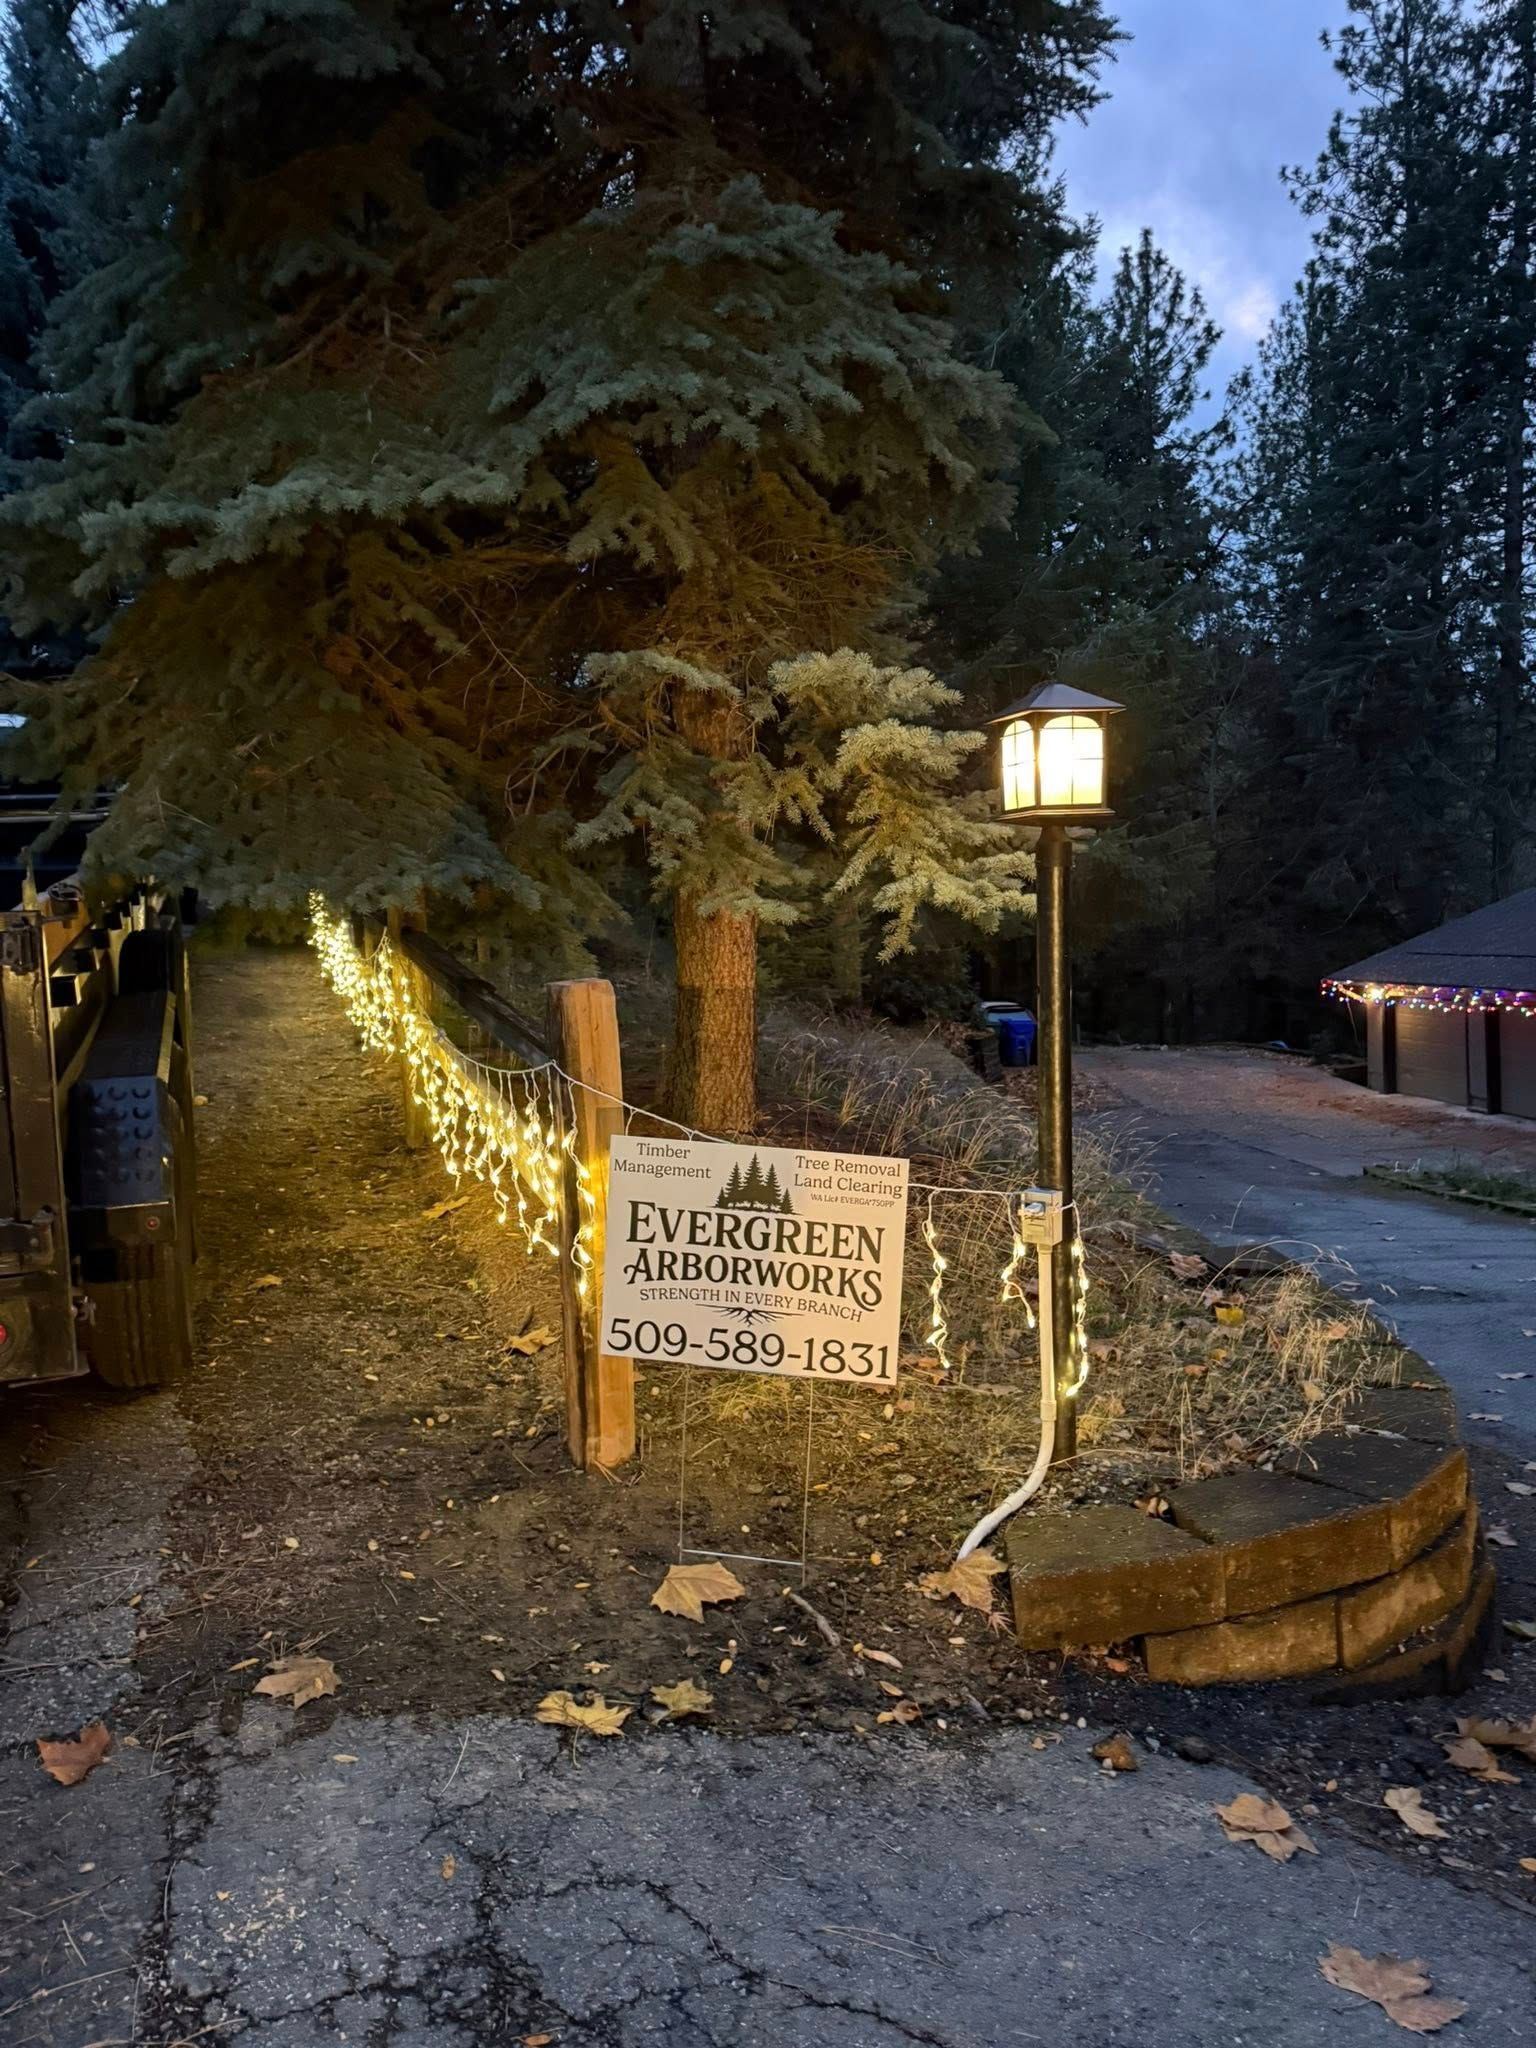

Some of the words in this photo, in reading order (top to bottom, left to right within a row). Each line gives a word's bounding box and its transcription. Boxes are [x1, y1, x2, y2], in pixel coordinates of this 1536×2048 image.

[636, 1143, 691, 1159] Timber
[613, 1158, 712, 1178] Management
[795, 1155, 830, 1170] Tree
[834, 1158, 900, 1177] Removal
[794, 1174, 832, 1189] Land
[837, 1178, 903, 1199] Clearing
[626, 1200, 885, 1264] EVERGREEN
[624, 1248, 882, 1312] ARBORWORKS
[640, 1288, 720, 1302] STRENGTH
[725, 1290, 740, 1303] IN
[745, 1292, 793, 1307] EVERY
[798, 1299, 862, 1322] BRANCH
[607, 1318, 891, 1379] 509-589-1831
